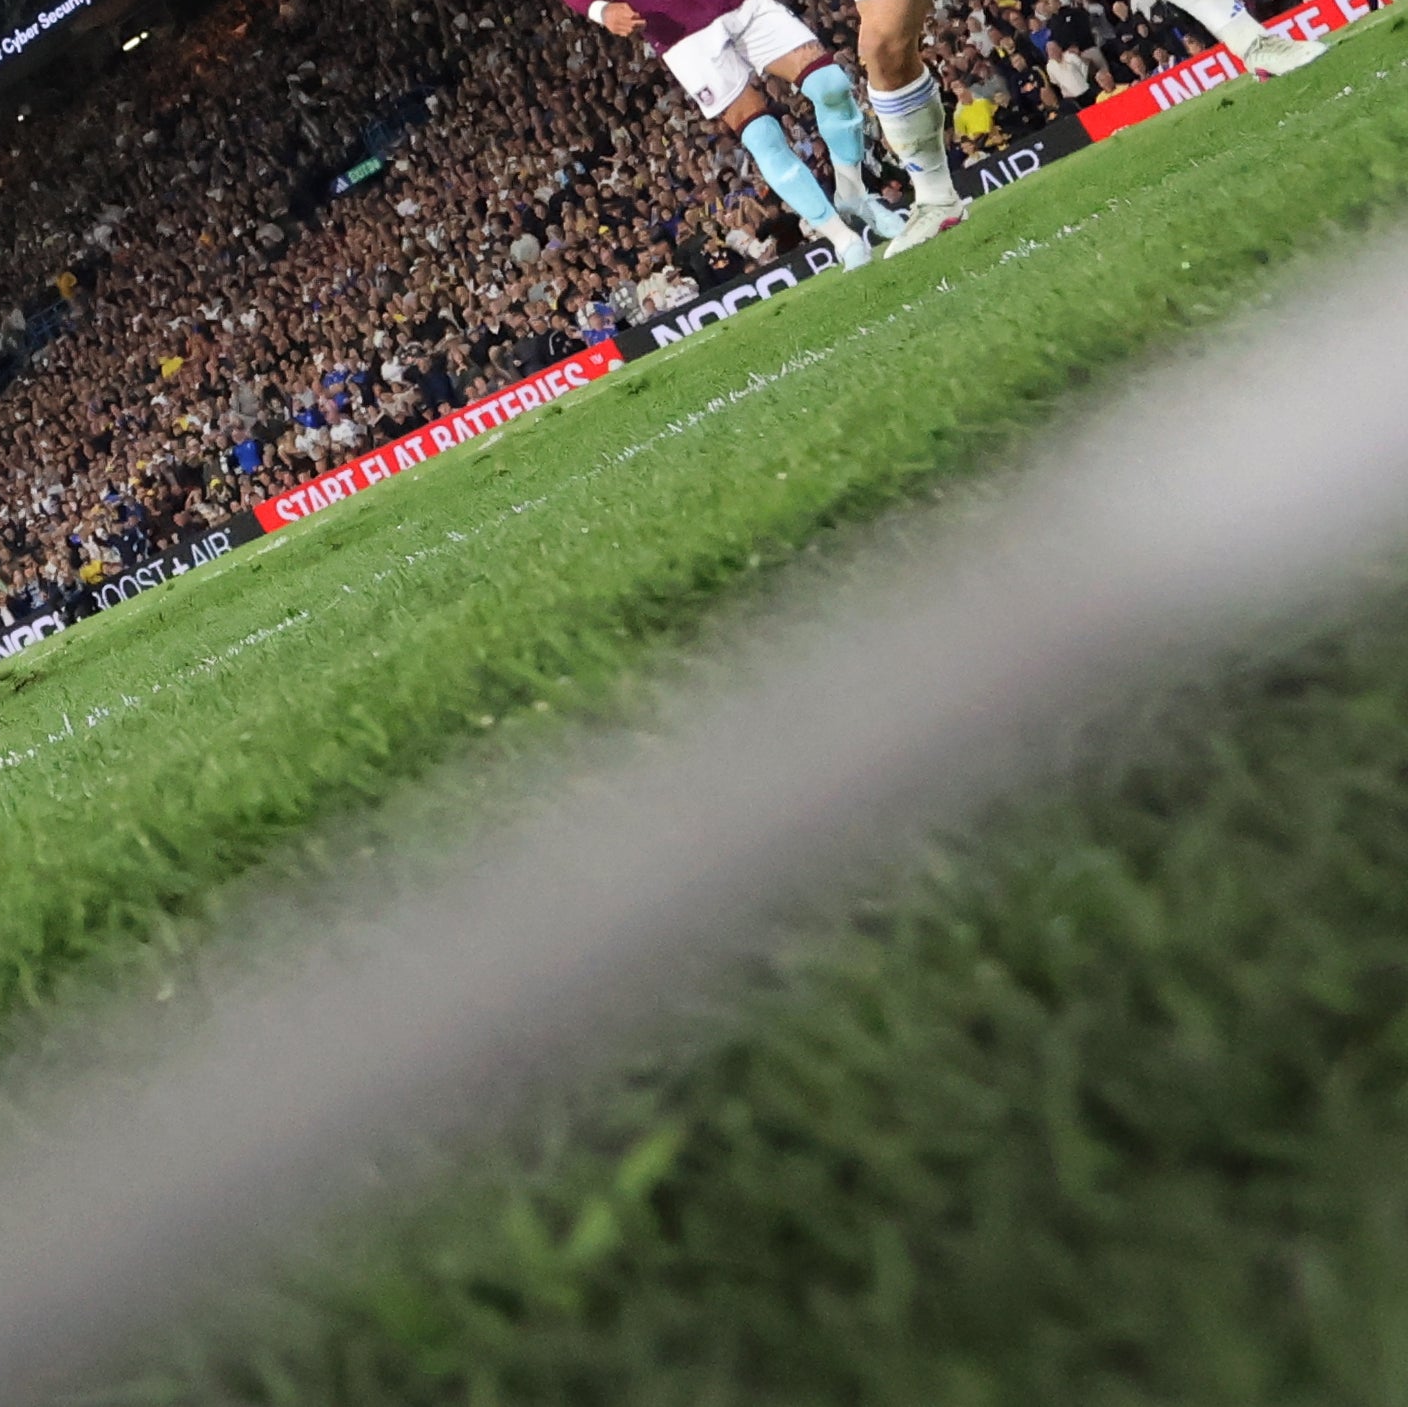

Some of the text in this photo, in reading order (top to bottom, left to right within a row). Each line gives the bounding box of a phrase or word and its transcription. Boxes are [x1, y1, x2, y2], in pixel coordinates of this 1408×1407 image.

[1, 21, 39, 55] Cyber
[979, 149, 1041, 194] AIR
[276, 468, 359, 522] START
[430, 362, 590, 453] BATTERIES
[190, 532, 233, 568] AIR
